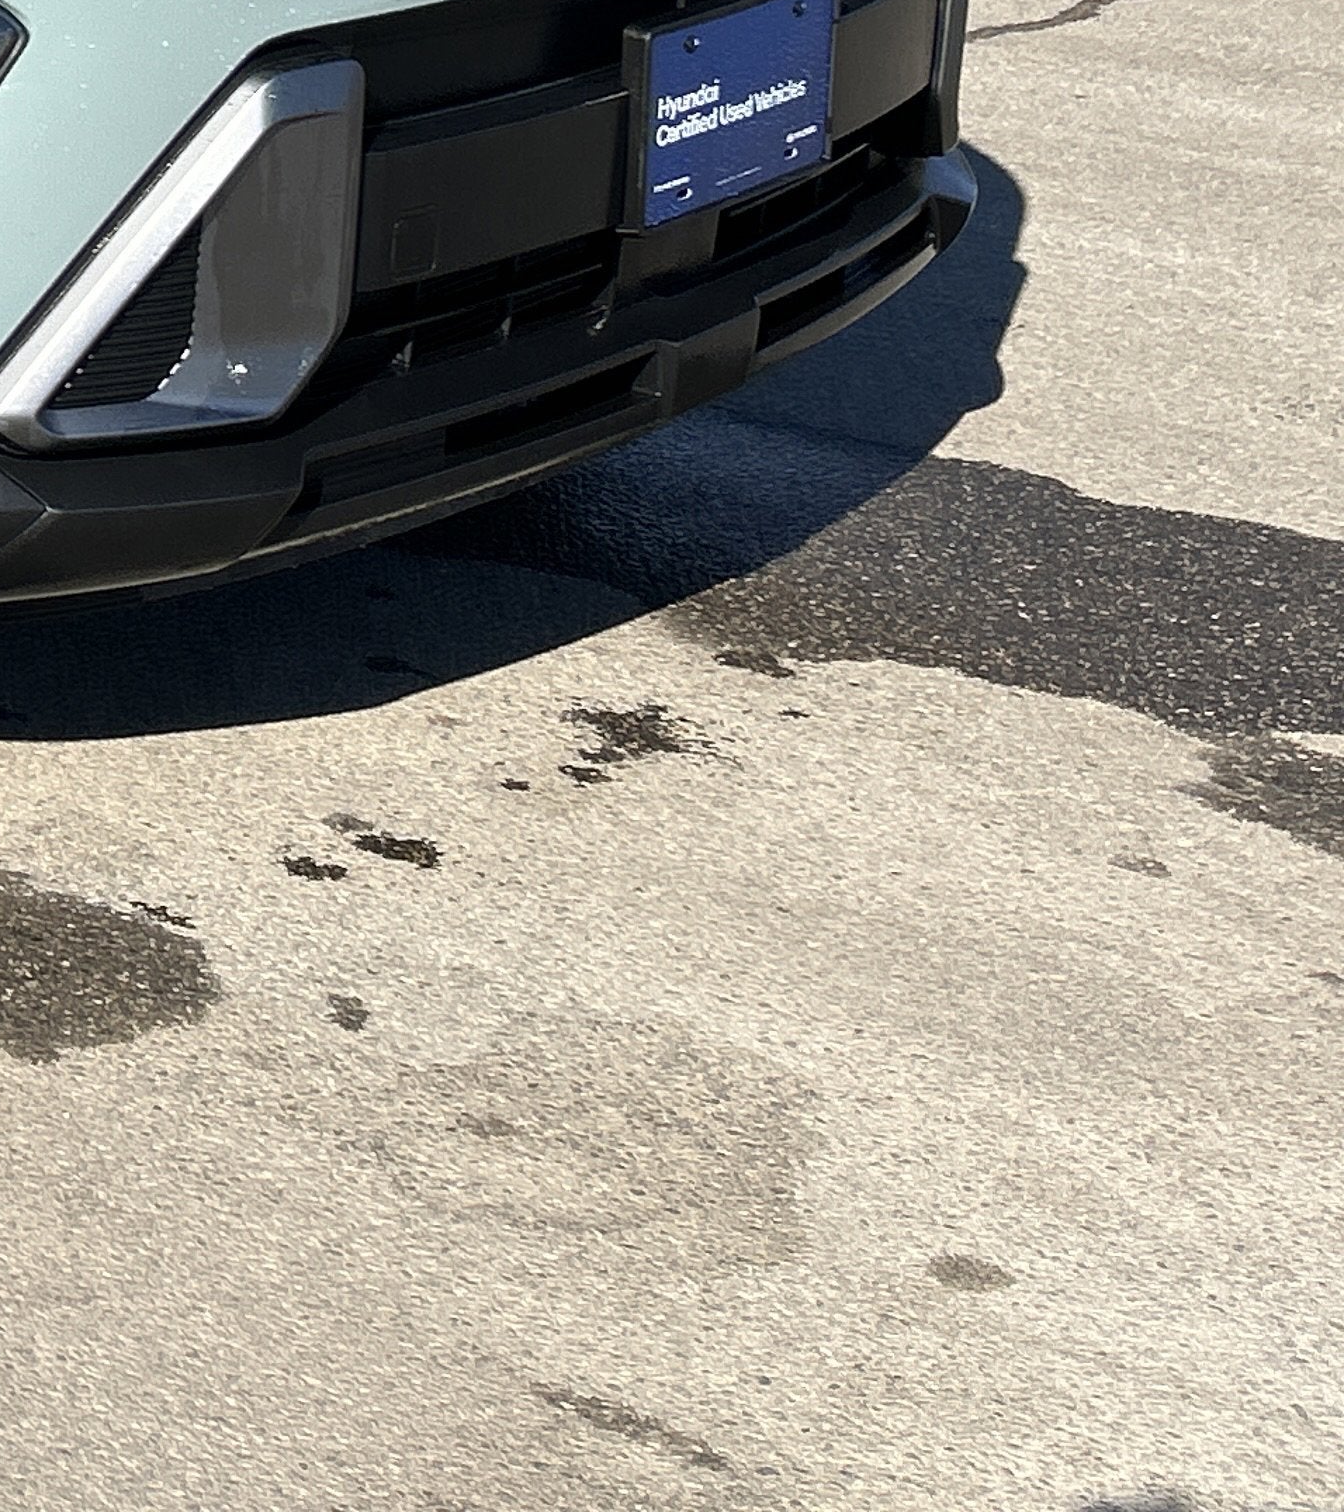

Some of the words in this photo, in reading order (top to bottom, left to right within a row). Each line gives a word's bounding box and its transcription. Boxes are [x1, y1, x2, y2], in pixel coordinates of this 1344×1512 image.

[655, 106, 719, 148] Certified
[719, 94, 754, 126] Used
[754, 79, 807, 112] Vehicles
[657, 78, 721, 121] Hyundai
